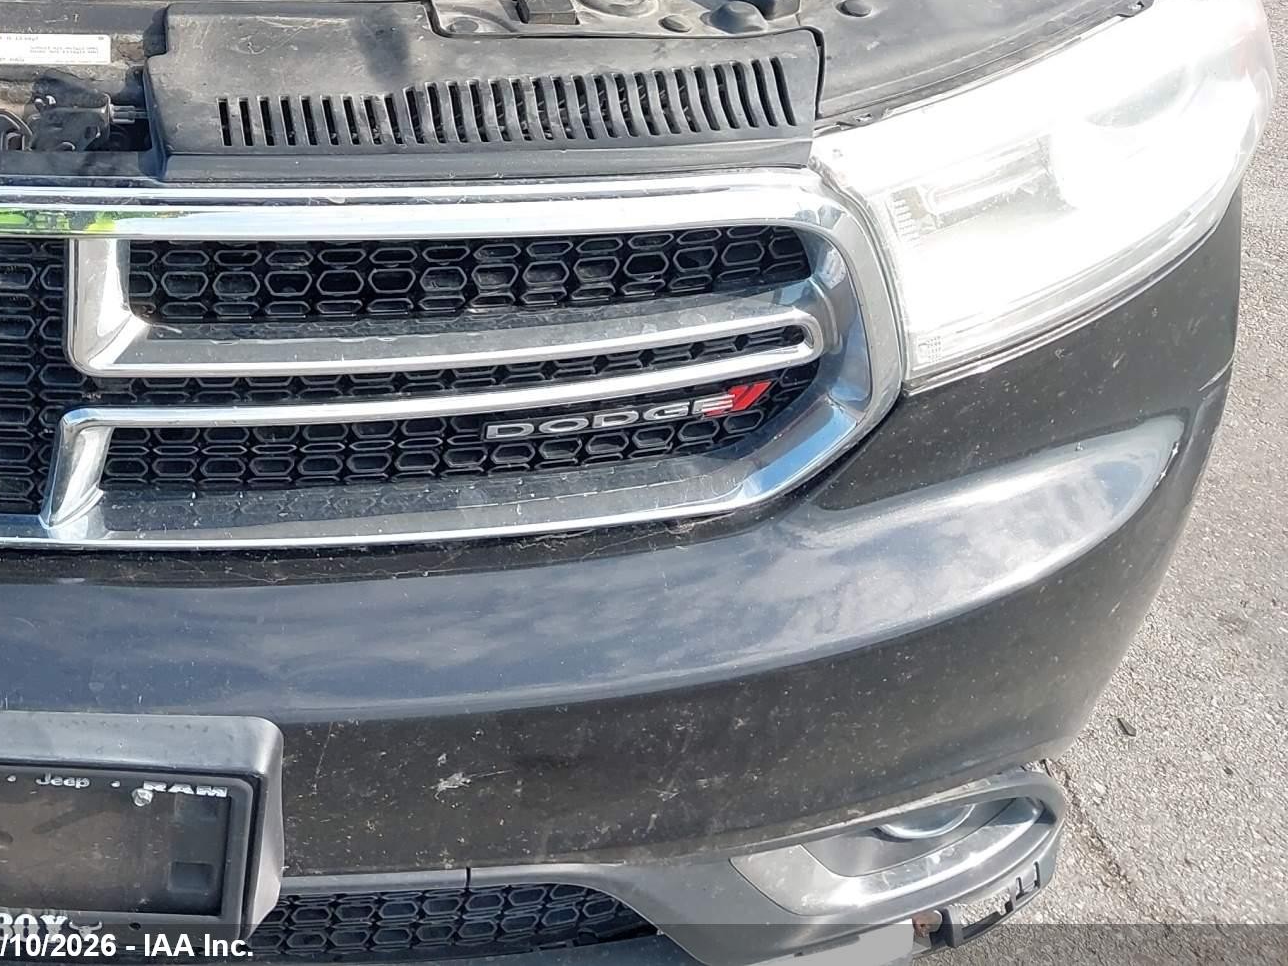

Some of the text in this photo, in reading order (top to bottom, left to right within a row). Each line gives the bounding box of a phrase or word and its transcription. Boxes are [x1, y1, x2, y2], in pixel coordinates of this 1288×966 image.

[486, 393, 736, 440] DODGE
[35, 772, 91, 789] Jeep
[143, 780, 228, 798] RAM
